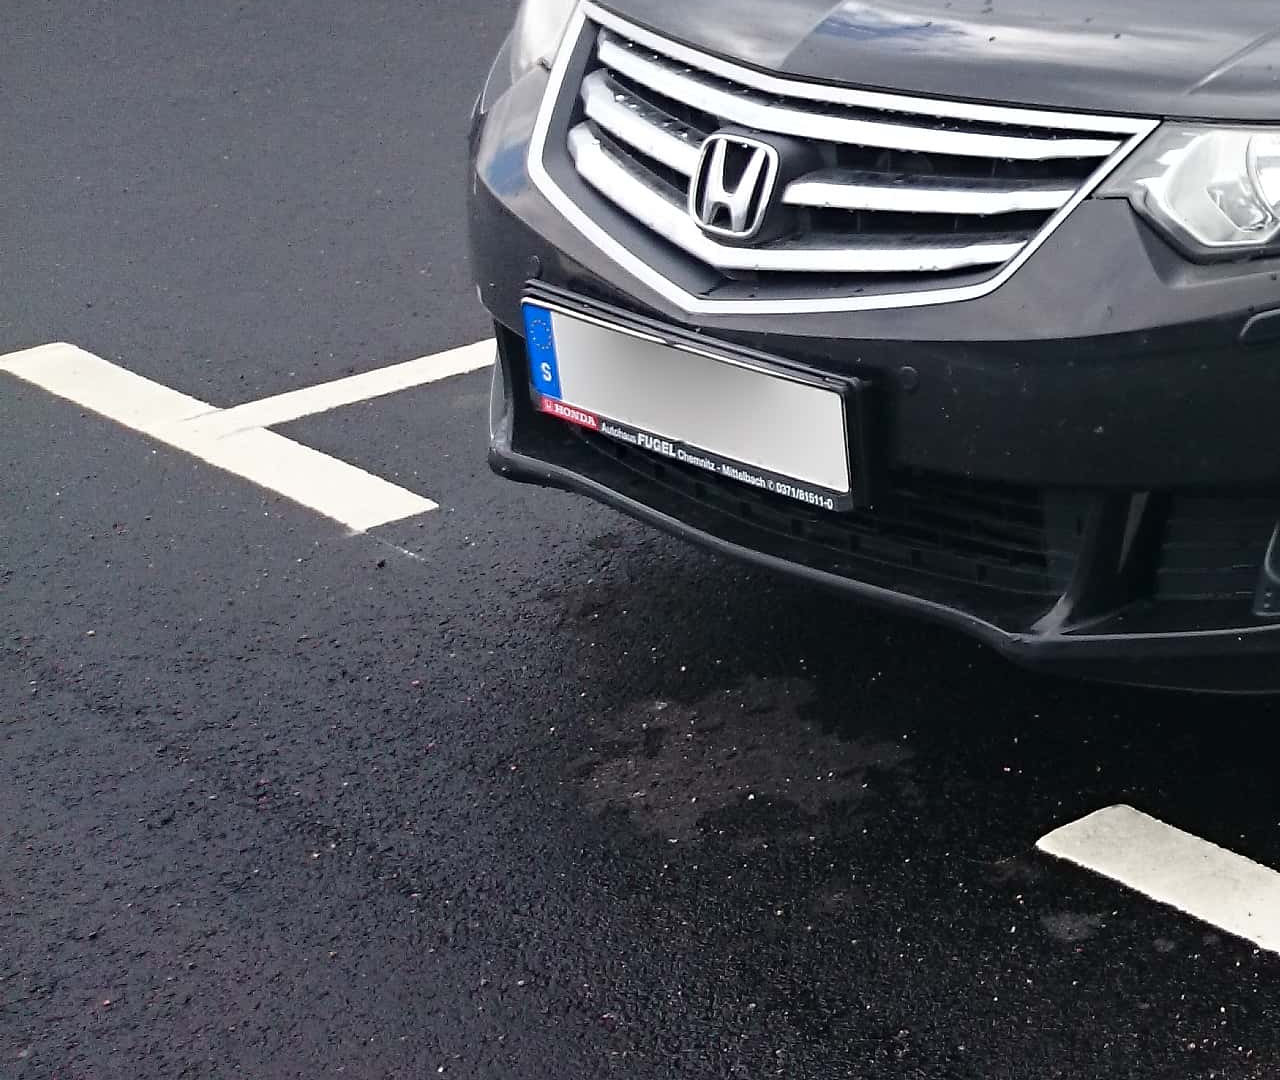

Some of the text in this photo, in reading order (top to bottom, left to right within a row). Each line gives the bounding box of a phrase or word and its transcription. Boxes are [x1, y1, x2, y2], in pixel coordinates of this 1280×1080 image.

[540, 361, 552, 382] S
[553, 403, 597, 427] HONDA
[601, 422, 637, 445] Autohaus
[637, 432, 677, 458] FUGEL
[677, 449, 716, 472] Chemnitz
